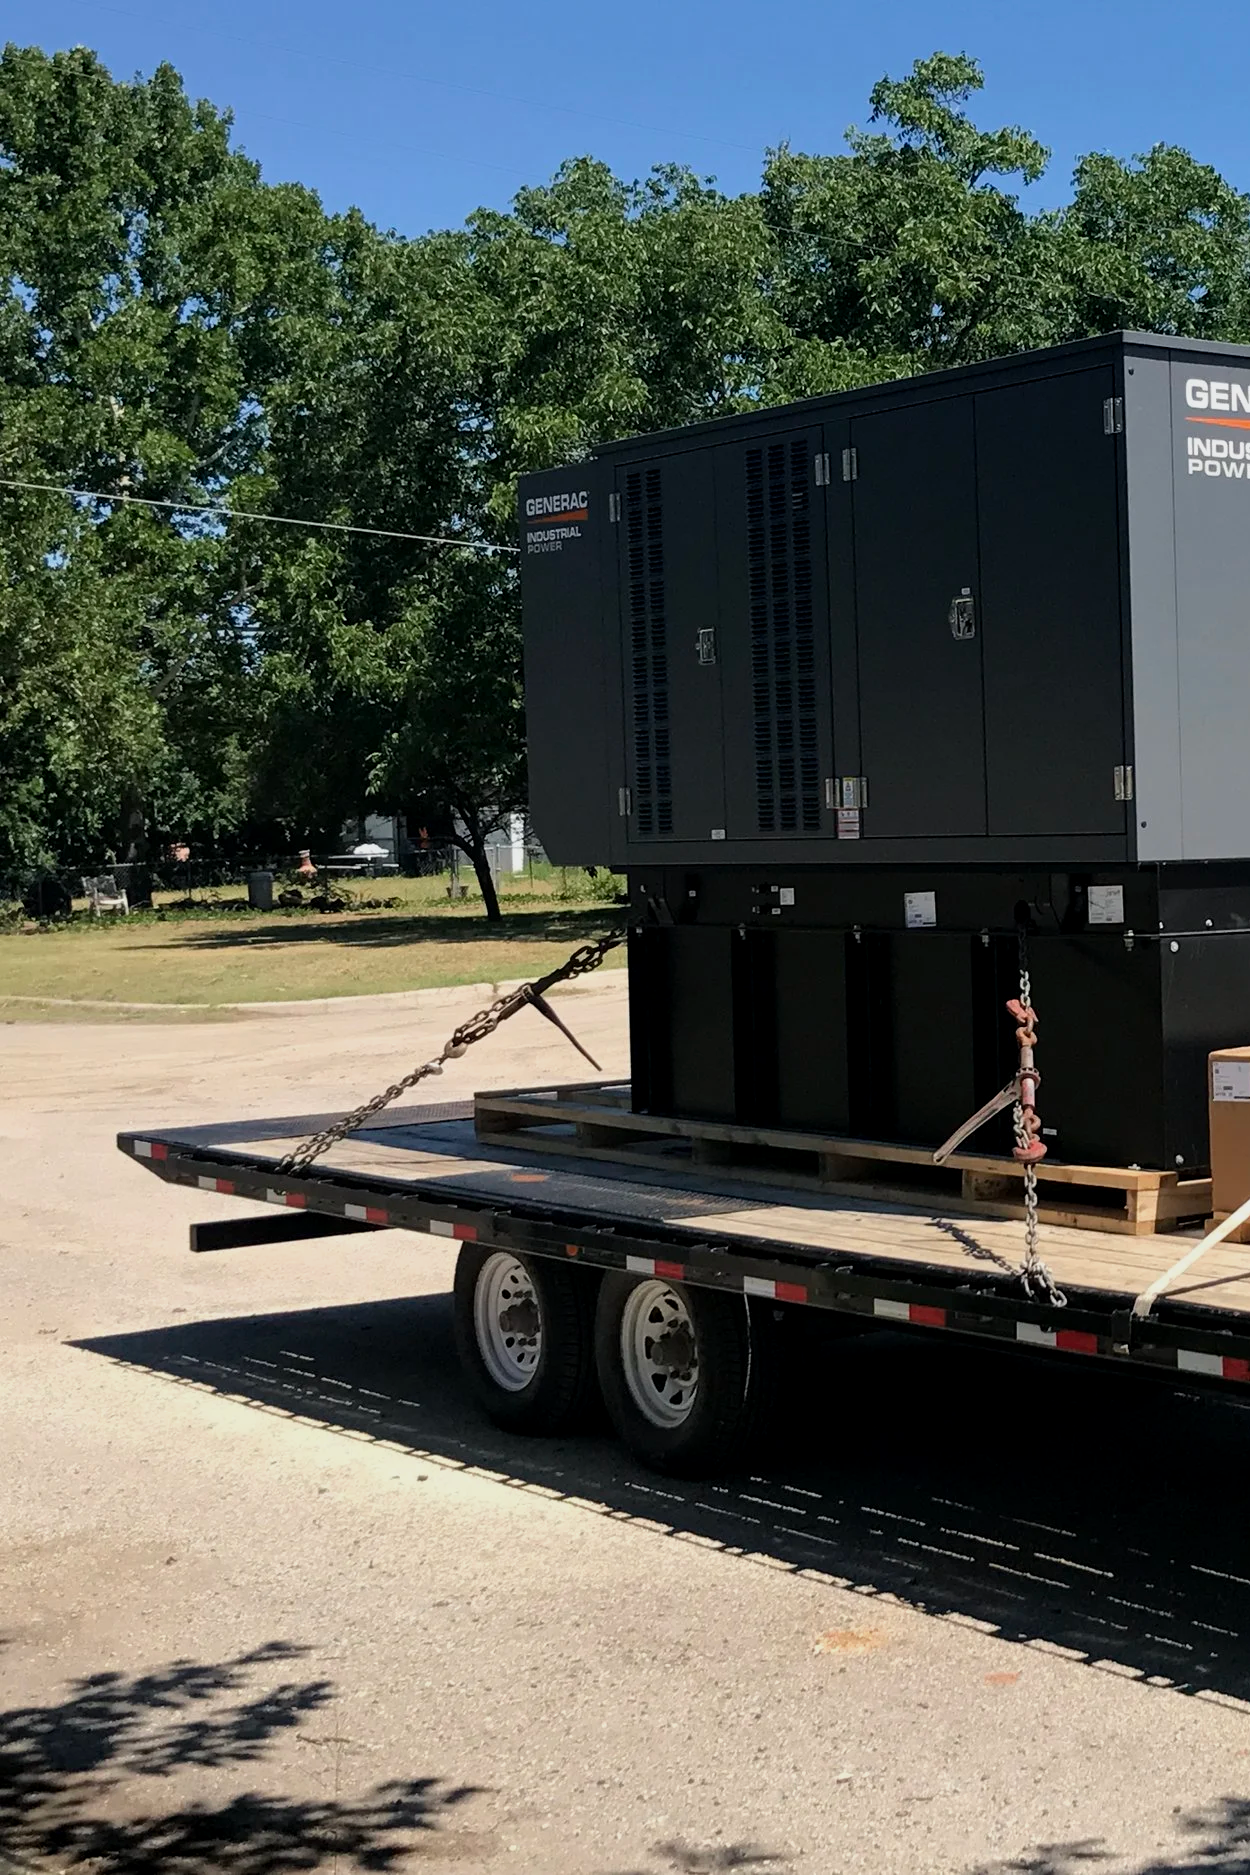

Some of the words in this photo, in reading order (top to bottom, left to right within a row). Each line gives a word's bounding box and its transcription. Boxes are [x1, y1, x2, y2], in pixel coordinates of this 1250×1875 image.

[526, 491, 588, 516] GENERAC
[527, 526, 582, 543] INDUSTRIAL
[527, 540, 562, 554] POWER
